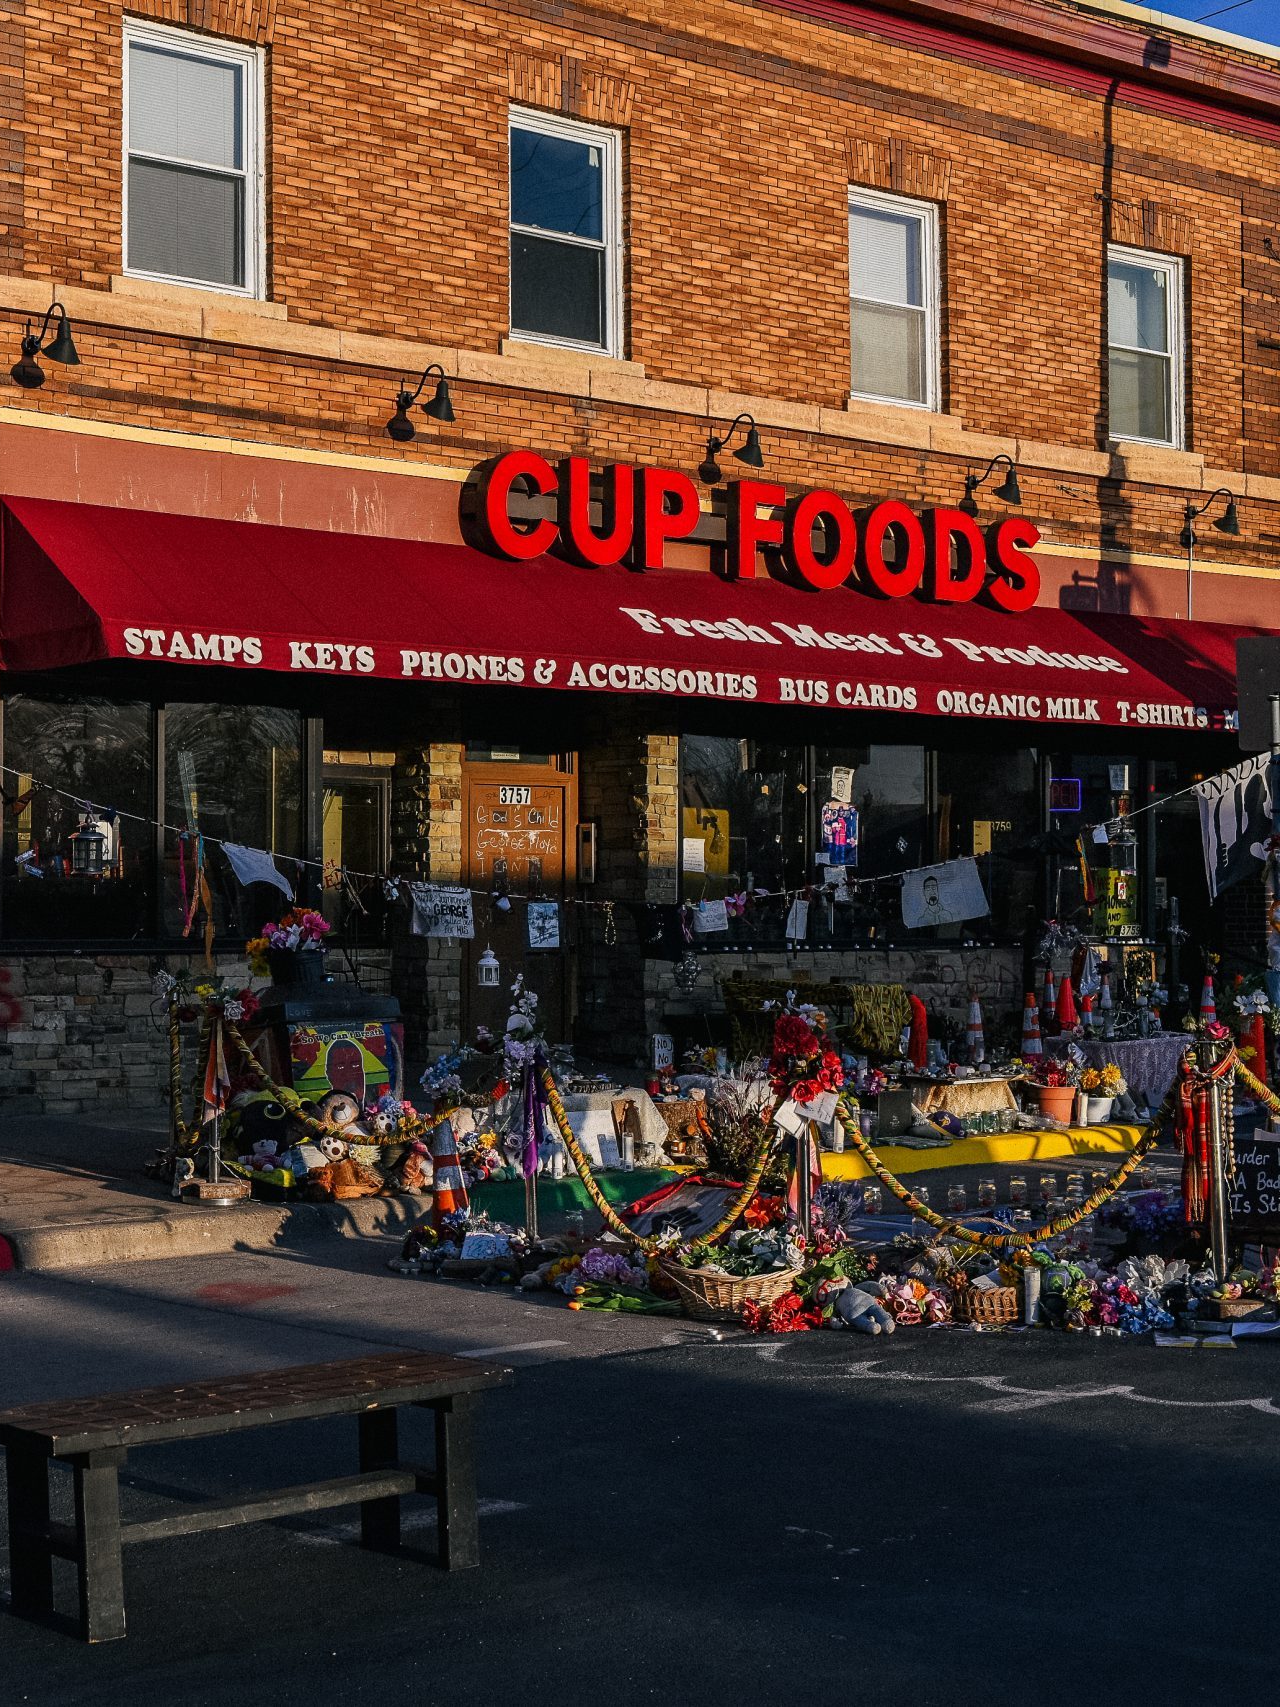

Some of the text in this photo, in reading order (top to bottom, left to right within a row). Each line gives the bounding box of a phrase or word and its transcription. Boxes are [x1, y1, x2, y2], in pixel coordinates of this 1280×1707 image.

[488, 452, 1041, 612] CUP FOODS
[619, 607, 1129, 675] Fresh Meat & Produce
[123, 628, 264, 665] STAMPS
[288, 641, 376, 673] KEYS
[399, 650, 525, 683] PHONES
[533, 658, 557, 685] &
[566, 661, 758, 699] ACCESSORIES
[778, 677, 830, 704] BUS
[835, 681, 918, 709] CARDS
[936, 689, 1041, 718] ORGANIC
[1045, 697, 1101, 721] MILK
[1116, 701, 1209, 728] T-SHIRTS
[501, 787, 530, 804] 3757
[1050, 783, 1078, 806] PEN
[527, 805, 560, 829] Child
[433, 904, 469, 919] GEORGE
[1107, 913, 1122, 922] AND
[301, 1035, 314, 1044] So
[315, 1034, 329, 1044] We
[354, 1028, 385, 1040] Breath
[1235, 1146, 1270, 1166] urder
[1236, 1171, 1247, 1190] A
[1231, 1193, 1280, 1214] Is St
